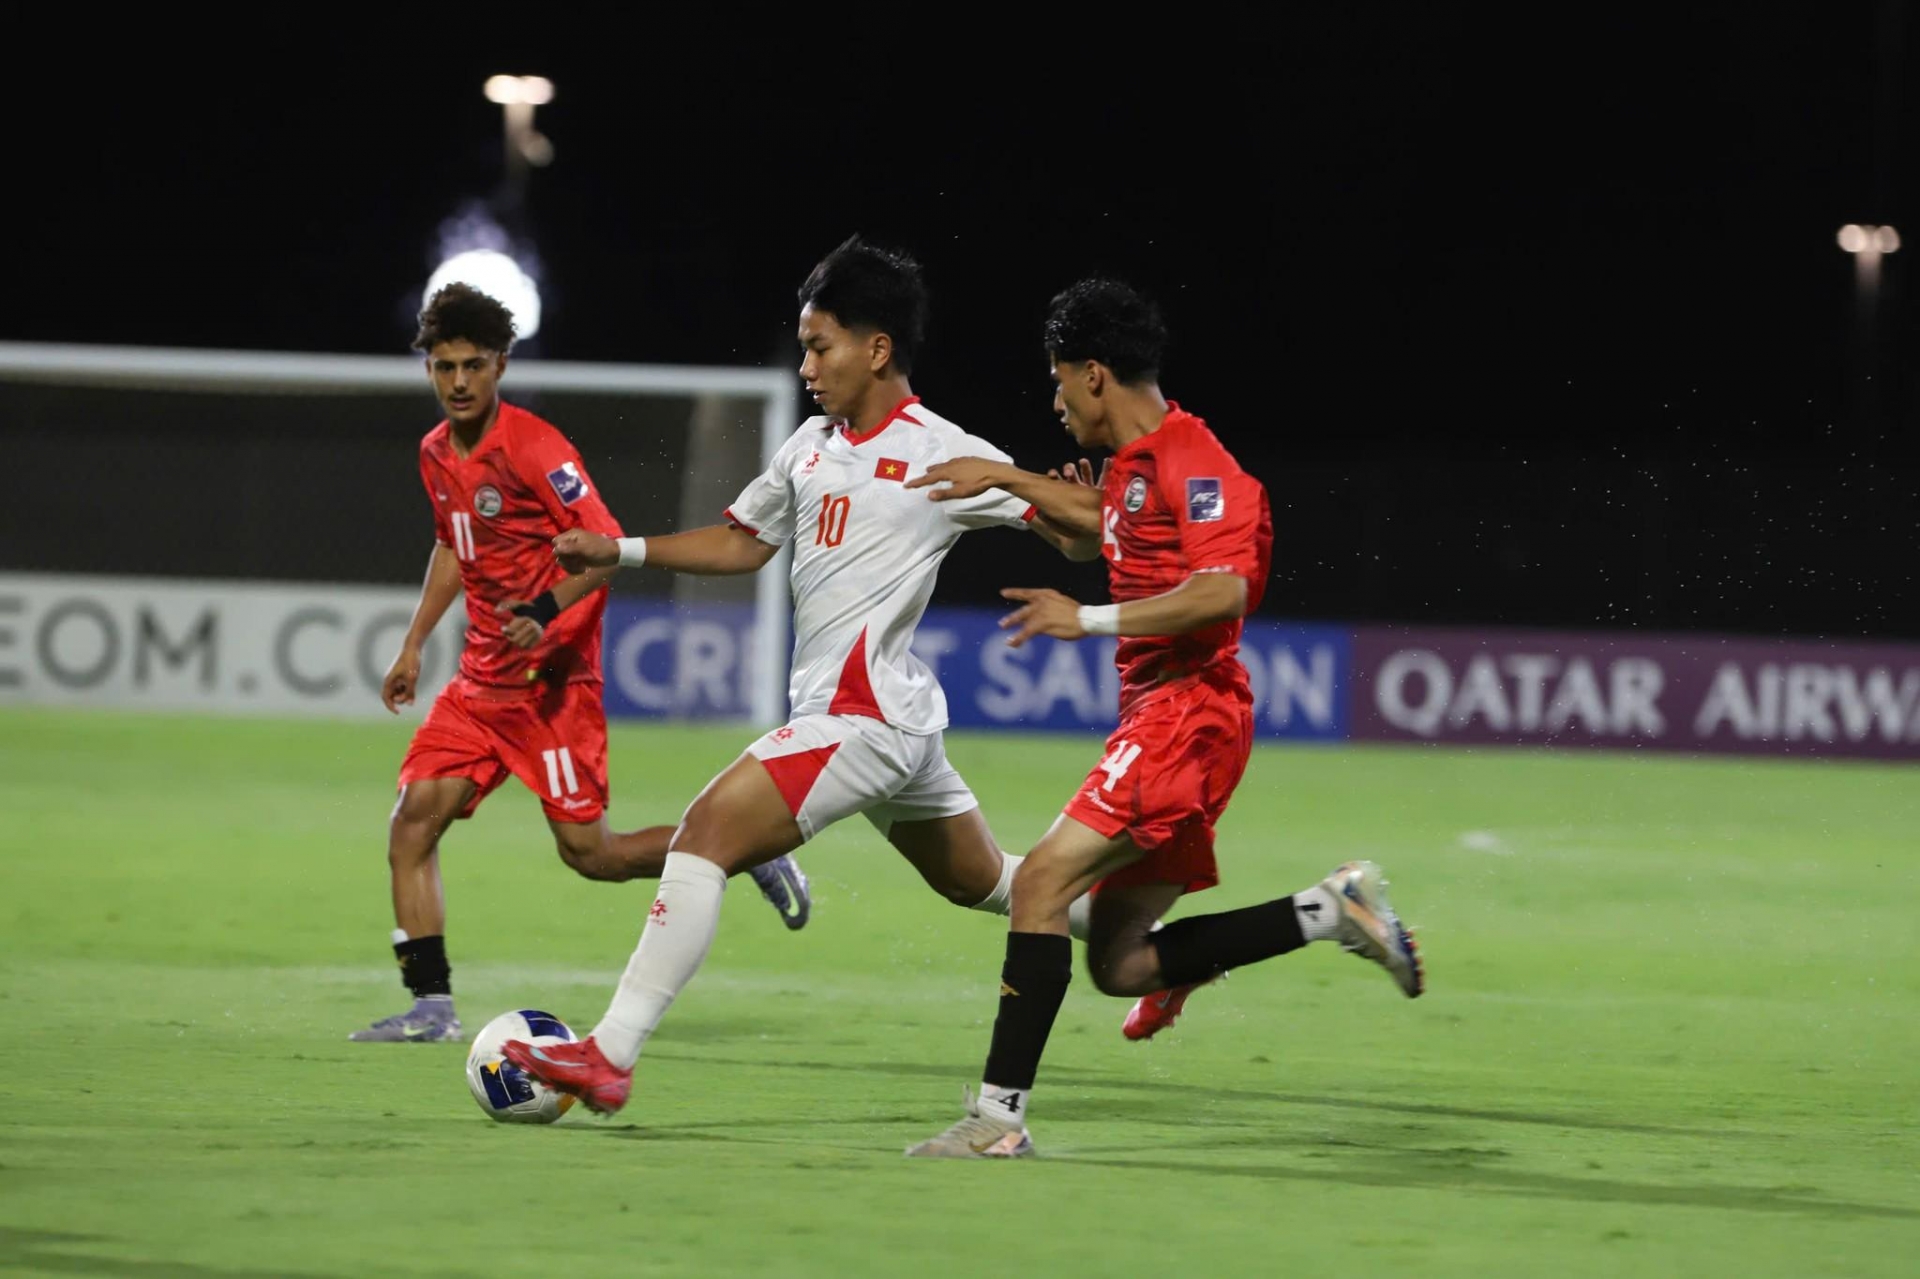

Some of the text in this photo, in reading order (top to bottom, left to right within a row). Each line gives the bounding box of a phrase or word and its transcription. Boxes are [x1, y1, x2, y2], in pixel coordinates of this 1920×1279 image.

[451, 512, 476, 561] 11
[816, 493, 850, 548] 10
[1376, 648, 1920, 744] QATAR AIRW
[542, 747, 579, 799] 11
[1100, 740, 1142, 793] 4
[999, 1092, 1020, 1112] 4
